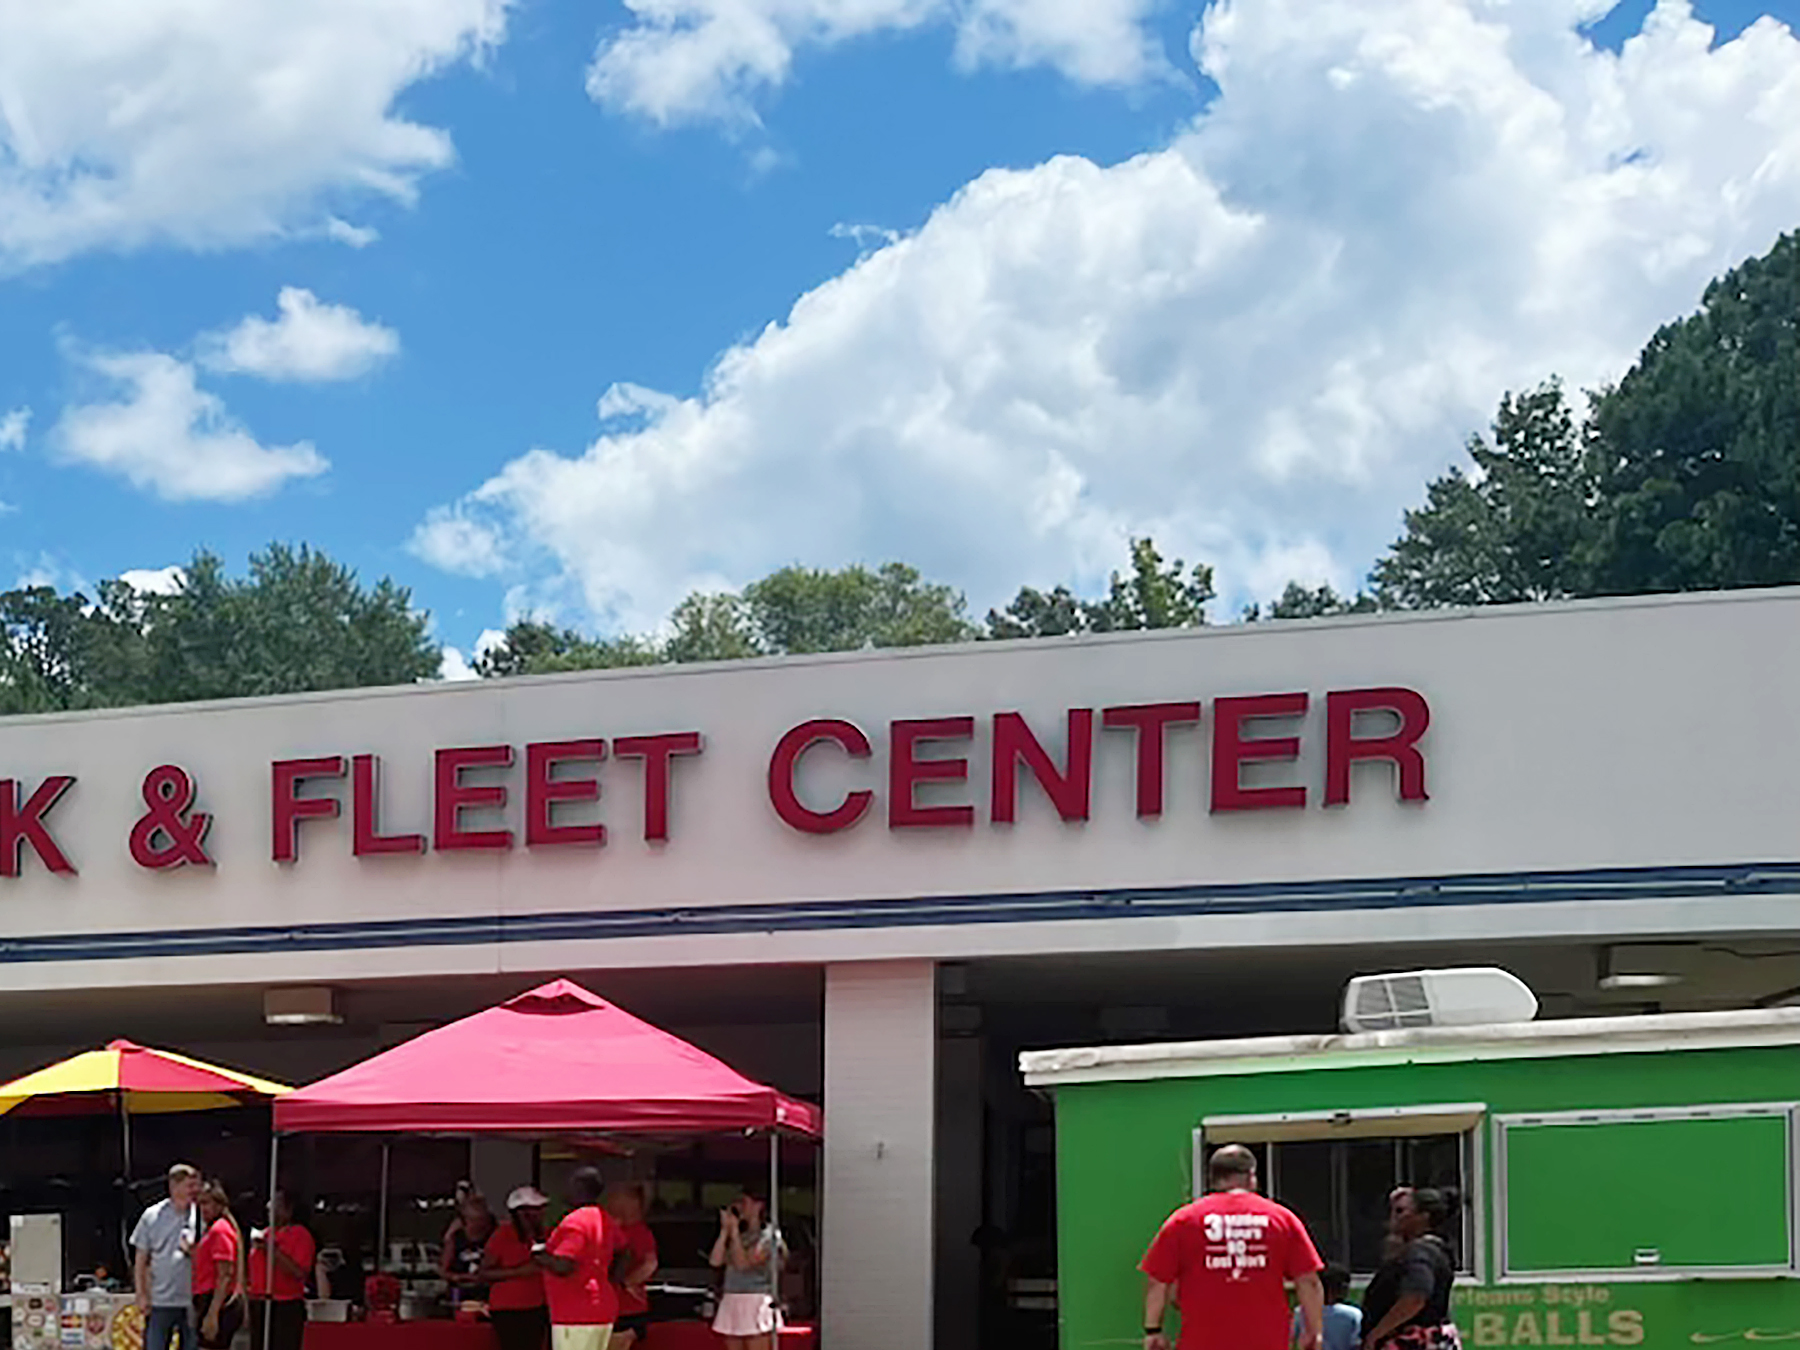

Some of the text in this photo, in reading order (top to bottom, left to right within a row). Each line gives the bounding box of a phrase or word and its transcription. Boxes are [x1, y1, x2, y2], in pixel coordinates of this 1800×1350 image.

[128, 762, 214, 871] &
[270, 730, 704, 864] FLEET
[766, 686, 1432, 834] CENTER
[1203, 1213, 1222, 1242] 3
[1453, 1285, 1611, 1307] rleans Style
[1461, 1309, 1645, 1347] -BALLS
